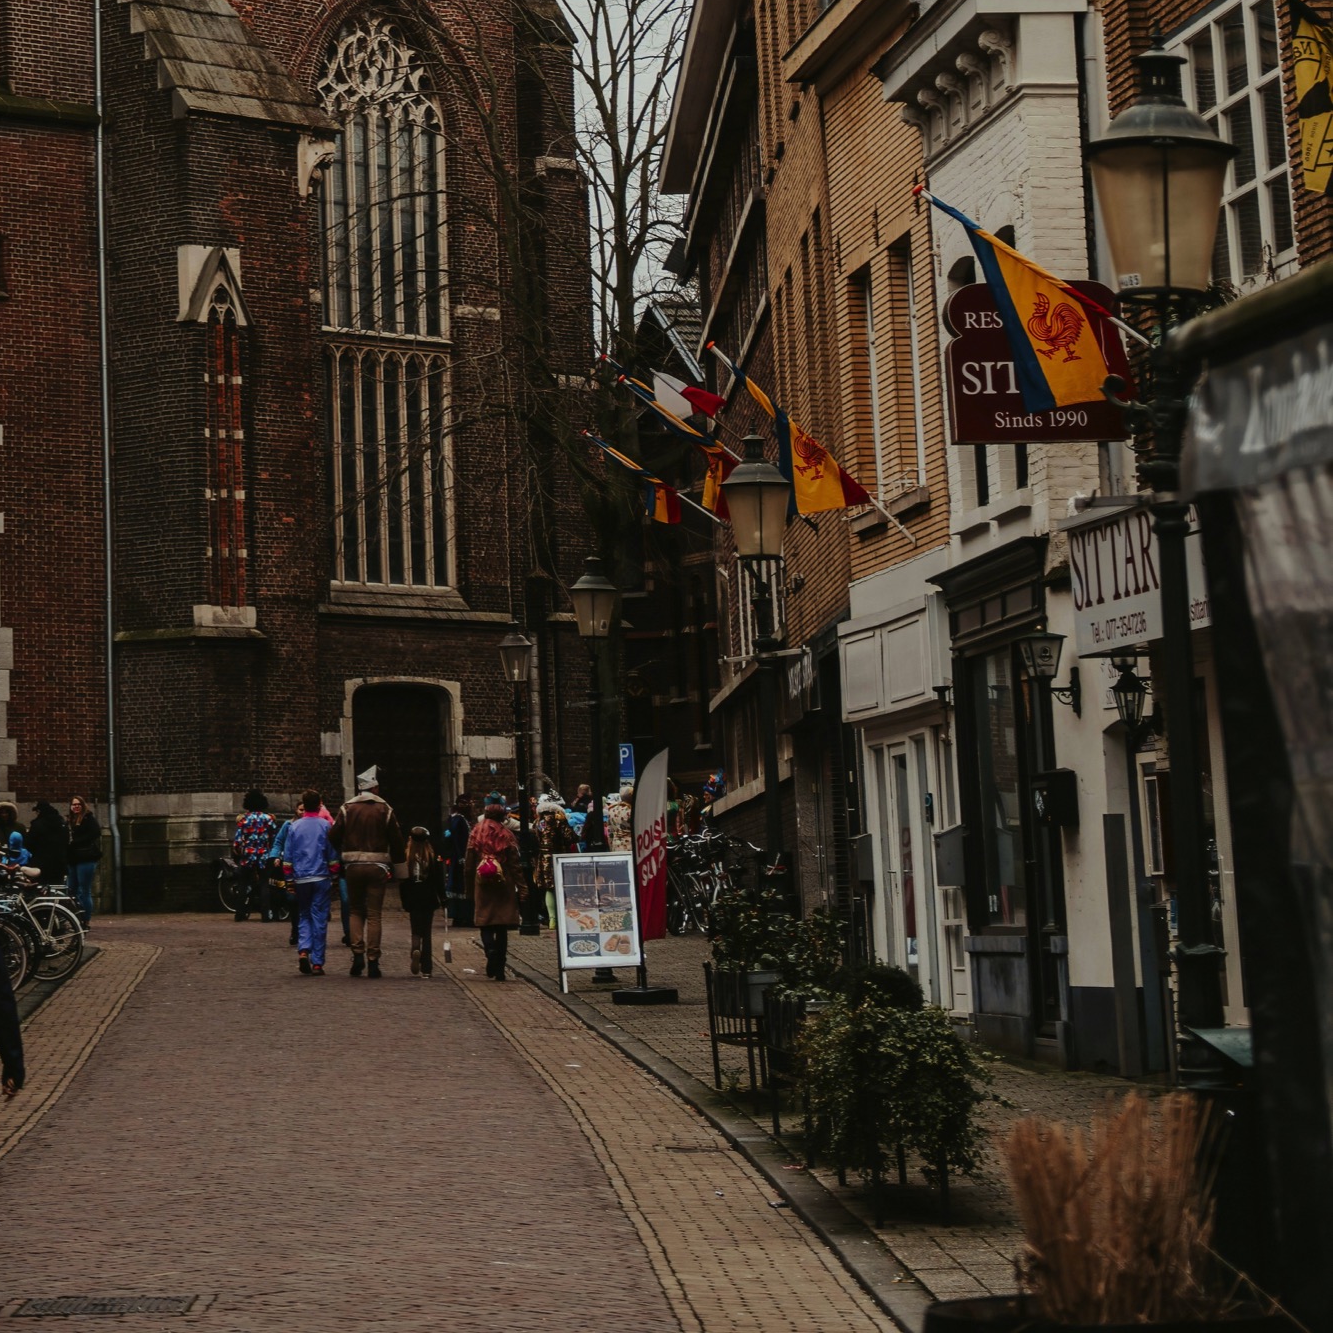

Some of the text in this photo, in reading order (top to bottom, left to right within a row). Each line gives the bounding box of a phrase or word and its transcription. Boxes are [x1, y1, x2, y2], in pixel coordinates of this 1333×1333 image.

[964, 311, 1004, 329] RES
[961, 361, 1020, 395] SIT
[994, 410, 1088, 429] Sinds 1990
